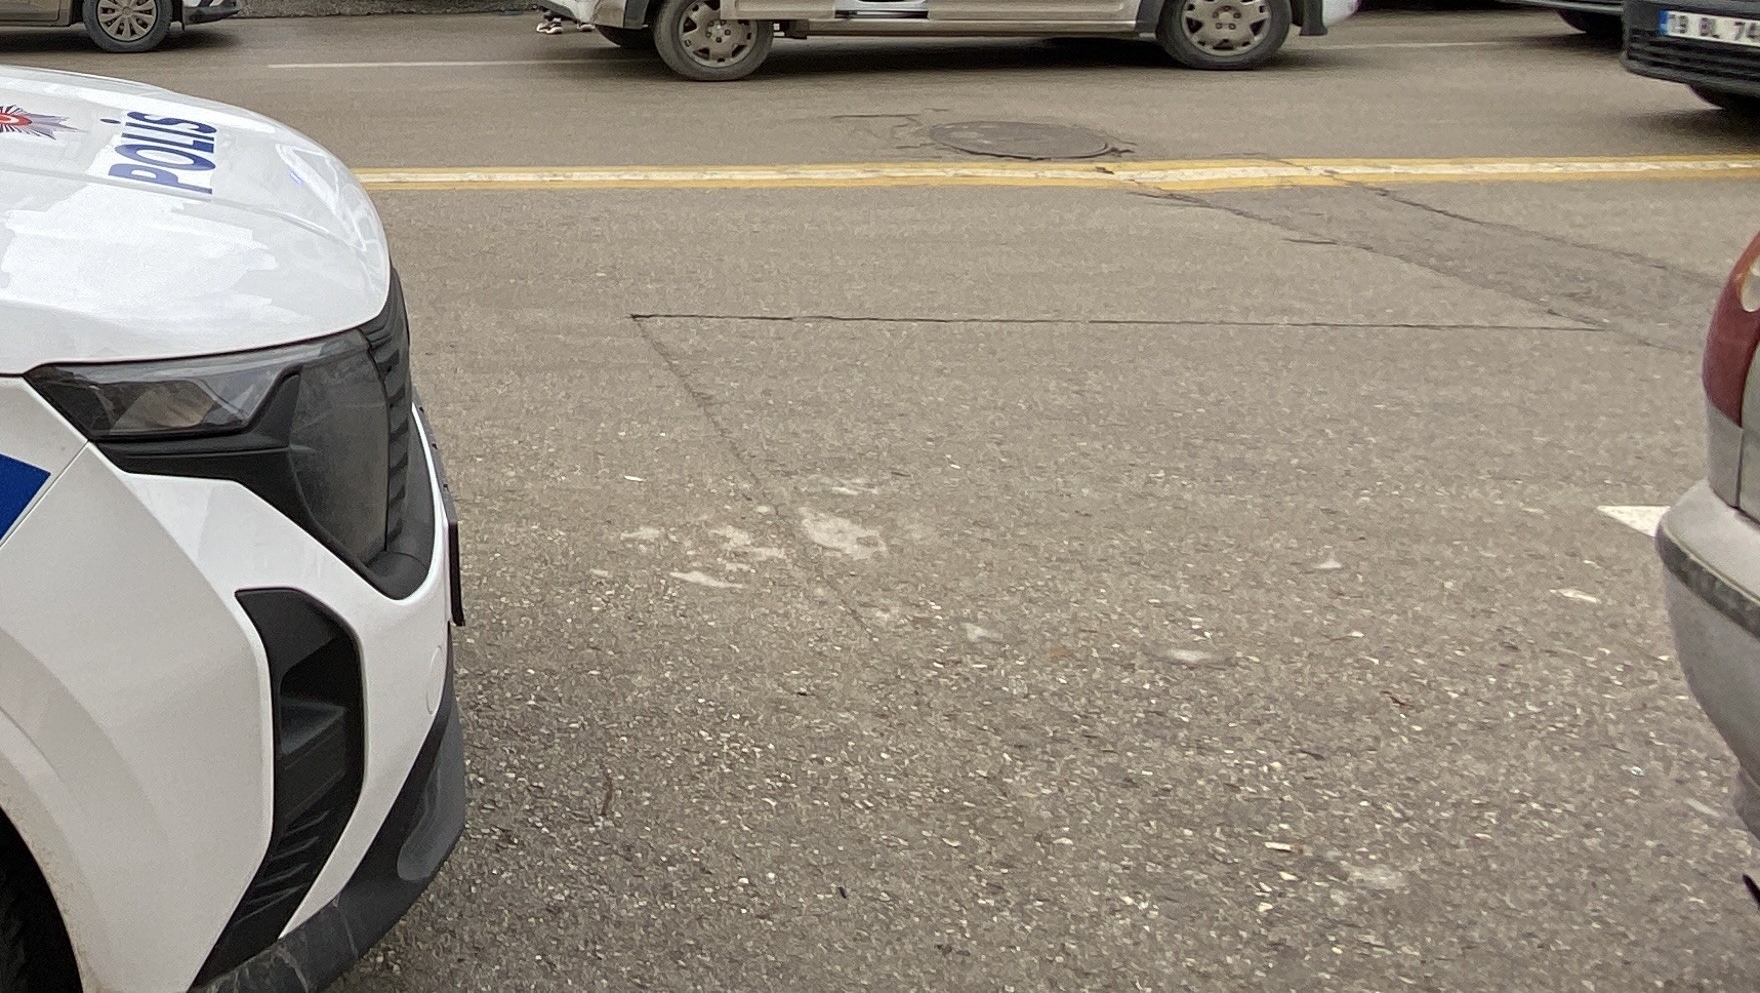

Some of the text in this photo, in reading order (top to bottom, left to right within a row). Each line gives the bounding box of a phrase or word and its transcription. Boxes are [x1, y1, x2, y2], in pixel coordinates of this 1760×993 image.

[1668, 14, 1688, 34] 19
[1699, 17, 1720, 39] BL
[101, 111, 218, 195] POLİS
